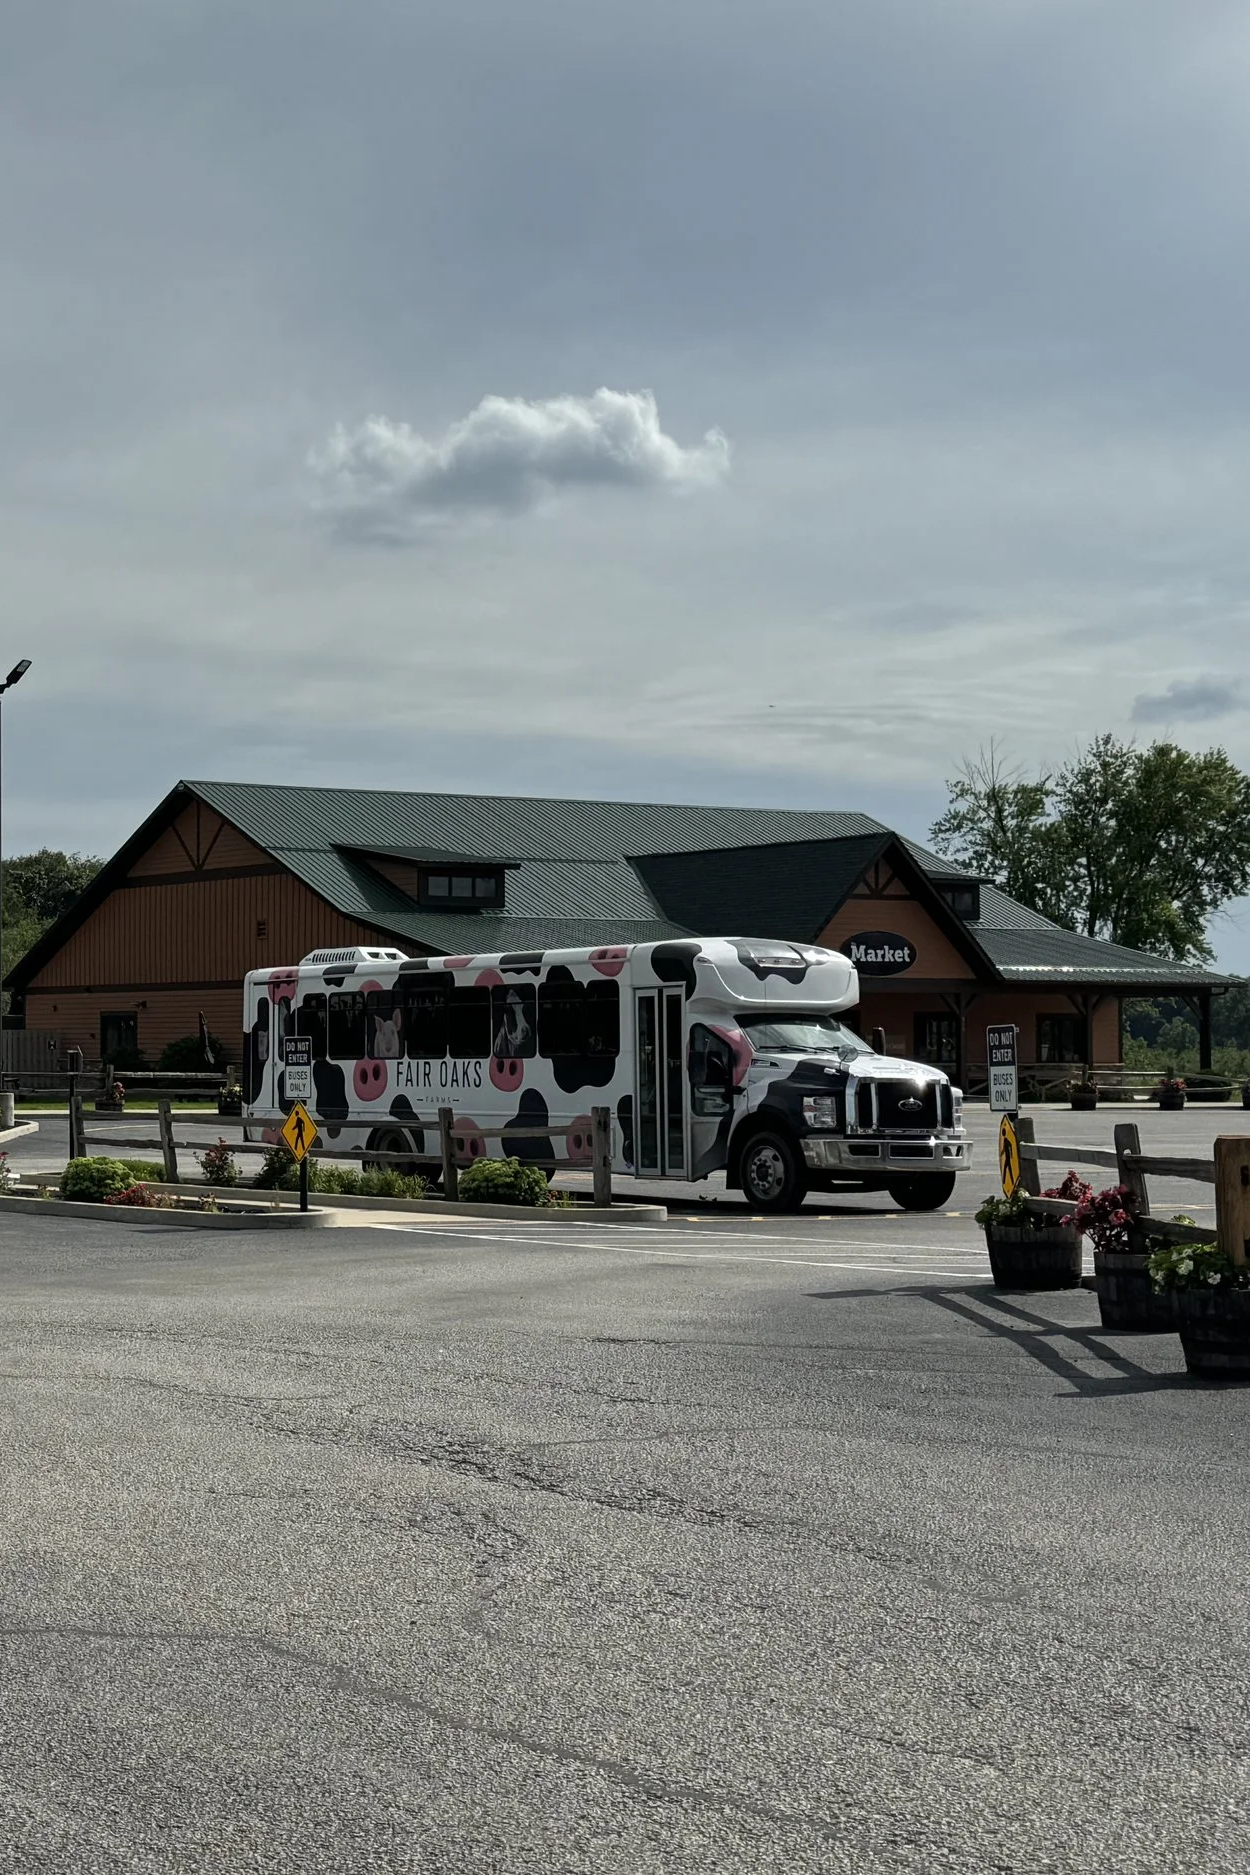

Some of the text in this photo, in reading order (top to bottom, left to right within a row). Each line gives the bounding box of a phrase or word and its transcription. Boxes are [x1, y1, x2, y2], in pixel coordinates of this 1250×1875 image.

[850, 945, 911, 962] Market
[990, 1032, 1013, 1046] DO NOT
[286, 1041, 309, 1051] DO NOT
[288, 1053, 308, 1063] ENTER
[992, 1049, 1013, 1062] ENTER
[288, 1070, 308, 1081] BUSES
[396, 1060, 482, 1088] FAIR OAKS
[993, 1073, 1013, 1086] BUSES
[290, 1082, 306, 1092] ONLY
[995, 1090, 1012, 1103] ONLY
